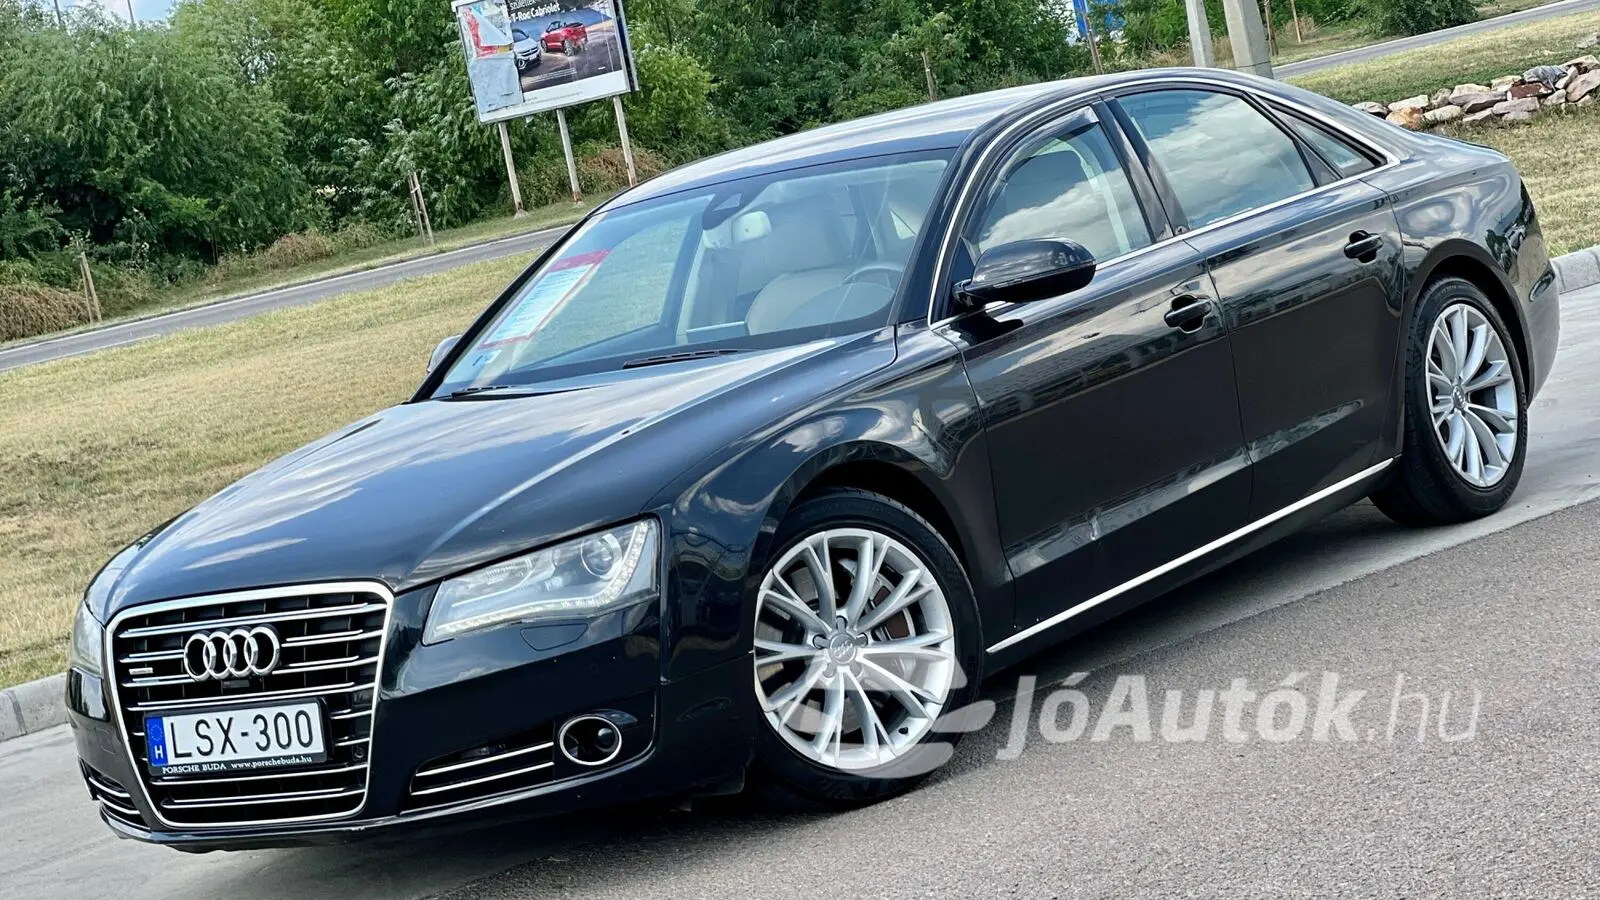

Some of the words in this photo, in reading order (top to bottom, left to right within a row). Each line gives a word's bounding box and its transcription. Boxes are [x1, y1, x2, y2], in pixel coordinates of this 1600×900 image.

[510, 11, 531, 22] T-Roc
[530, 3, 561, 17] Cabriolet
[170, 709, 314, 759] LSX-300
[154, 745, 164, 760] H
[162, 764, 200, 774] PORSCHE
[202, 762, 227, 771] BUDA
[231, 755, 313, 769] www.porschebuda.hu
